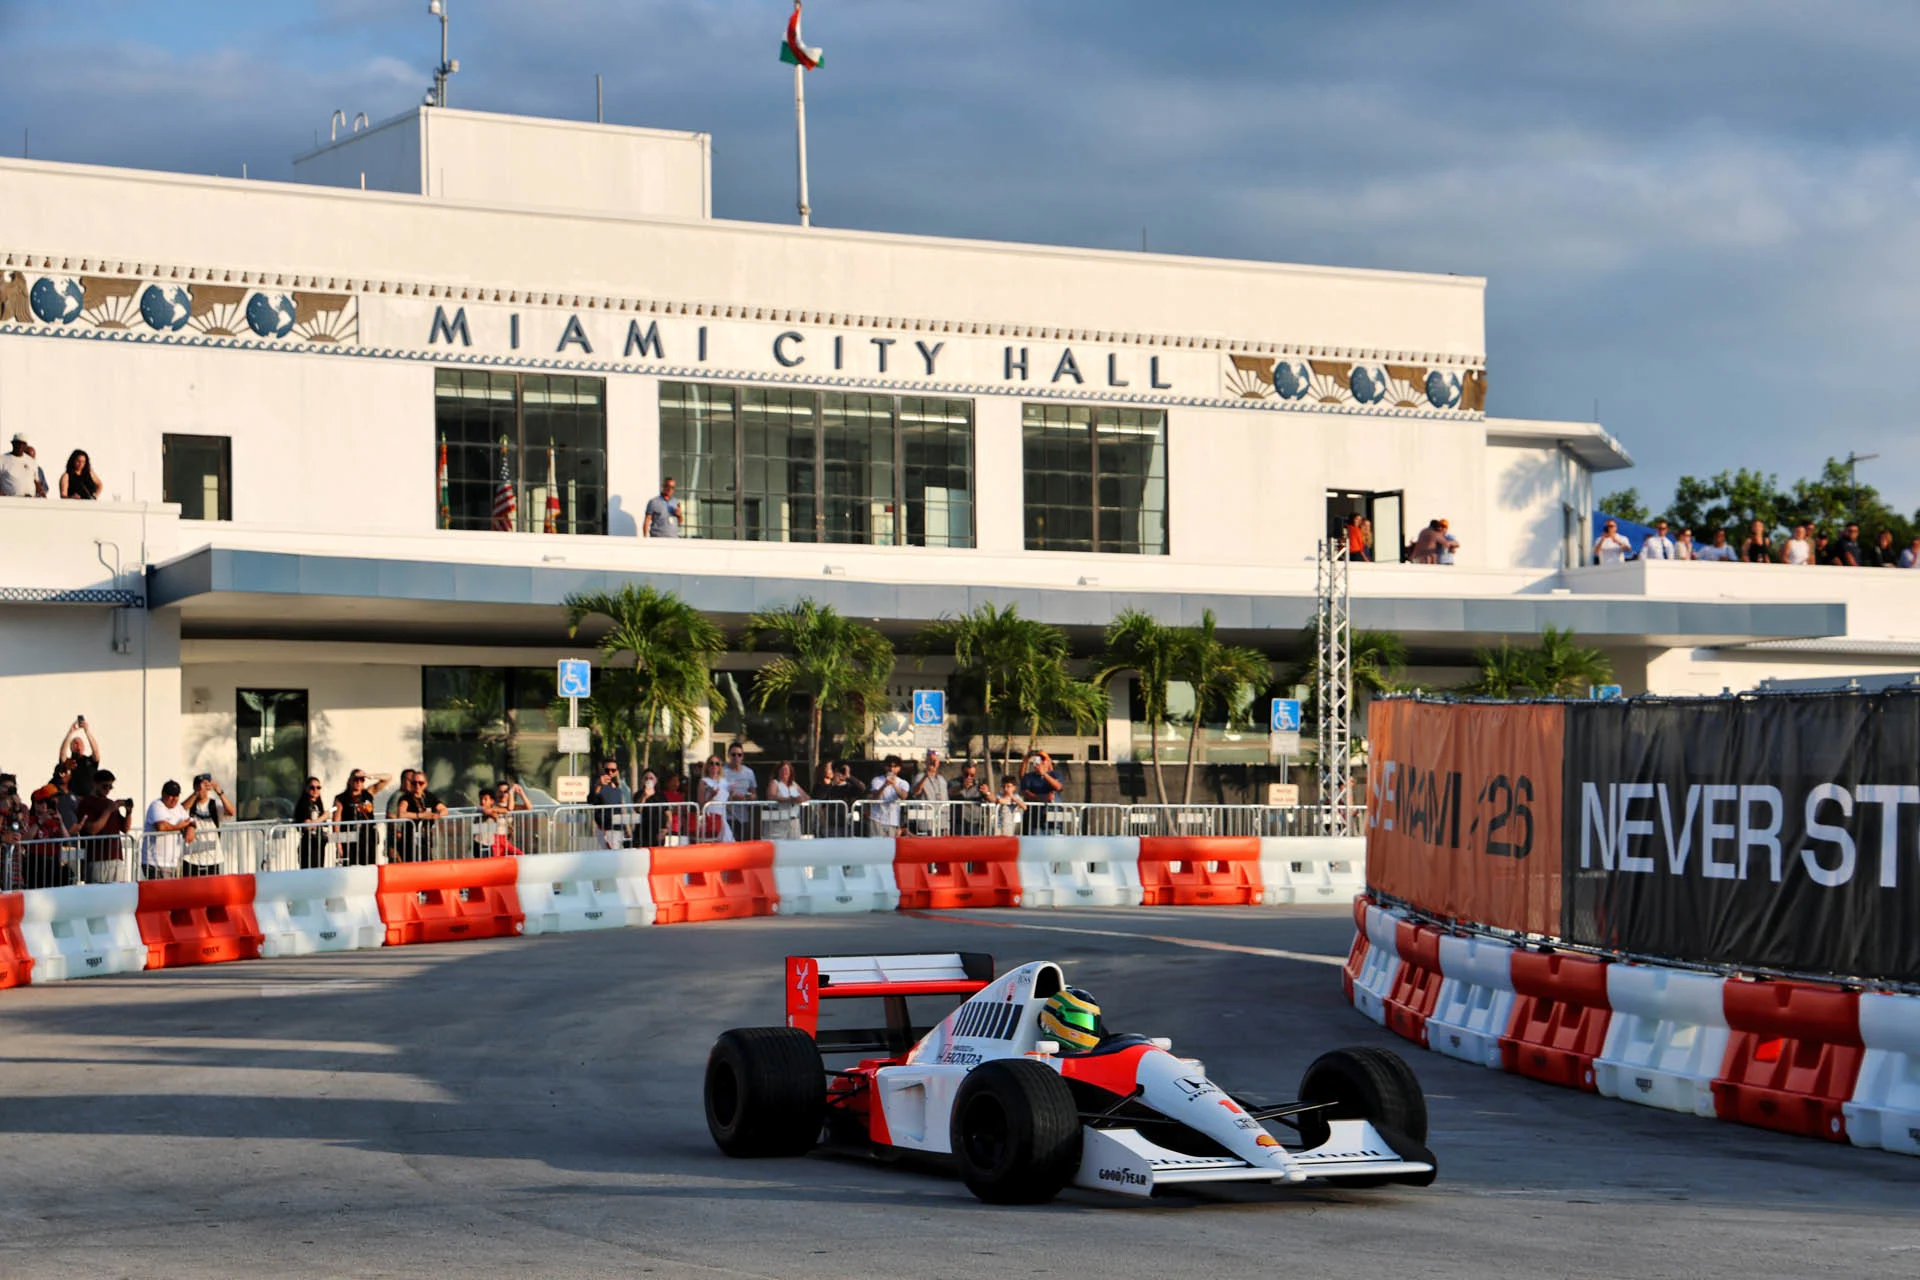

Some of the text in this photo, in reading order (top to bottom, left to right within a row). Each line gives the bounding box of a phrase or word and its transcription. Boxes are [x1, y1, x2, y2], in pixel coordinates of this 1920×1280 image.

[428, 305, 1172, 390] MIAMI CITY HALL
[1580, 781, 1920, 888] NEVER ST
[943, 1052, 983, 1065] HONDA
[1098, 1166, 1147, 1186] GOODYEAR
